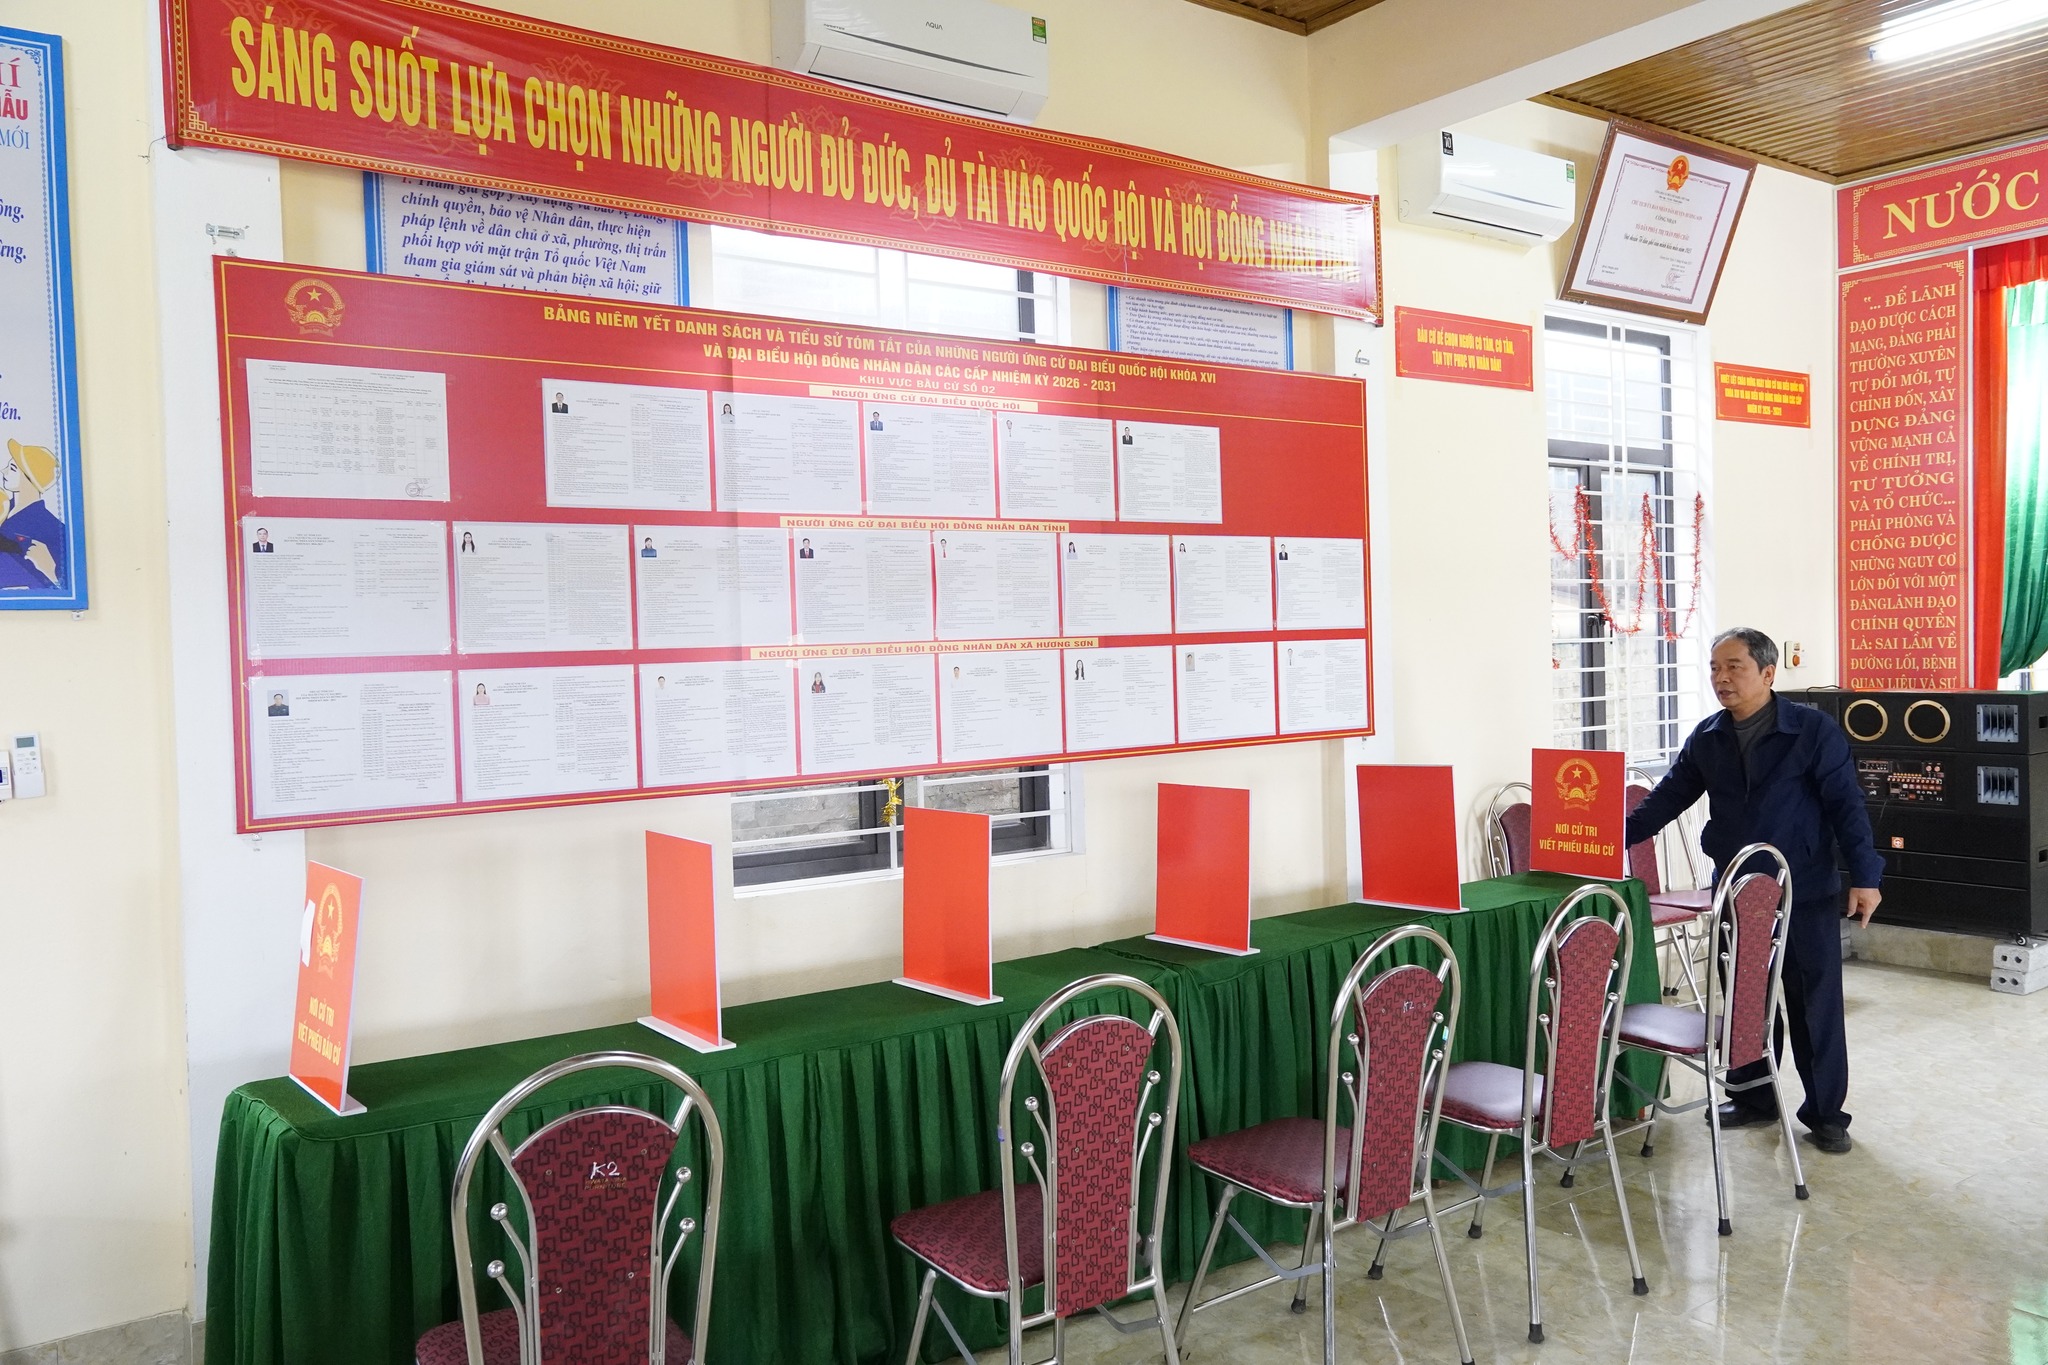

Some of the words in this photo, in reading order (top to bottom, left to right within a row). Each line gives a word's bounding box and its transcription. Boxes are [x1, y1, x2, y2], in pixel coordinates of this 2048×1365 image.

[925, 21, 944, 30] AQUA
[0, 88, 29, 121] ẪU
[230, 6, 338, 112] SÁNG
[350, 26, 440, 129] SUỐT
[450, 61, 516, 155] LỰA
[524, 76, 612, 171] CHỌN
[620, 90, 723, 179] NHỮNG
[730, 112, 814, 193] NGƯỜI
[821, 116, 855, 200] ĐỦ
[862, 133, 919, 219] ĐỨC,
[924, 137, 958, 219] ĐỦ
[962, 151, 998, 225] TÀI
[1004, 159, 1045, 232] VÀO
[1052, 166, 1108, 242] QUỐC
[1113, 181, 1146, 259] HỘI
[1151, 188, 1177, 254] VÀ
[1181, 194, 1212, 269] HỘI
[1216, 194, 1266, 267] ĐỒNG
[1269, 213, 1316, 275] NHÂN
[402, 193, 438, 208] chính
[443, 198, 485, 216] quyền,
[489, 204, 511, 218] bảo
[515, 208, 528, 223] vệ
[532, 210, 565, 225] Nhân
[569, 215, 594, 231] dân,
[598, 219, 623, 236] thực
[627, 223, 650, 239] hiện
[1882, 168, 2040, 240] NƯỚC
[402, 213, 434, 231] pháp
[439, 216, 466, 233] lệnh
[471, 219, 484, 234] về
[488, 223, 510, 237] dân
[515, 227, 537, 241] chủ
[541, 230, 550, 242] ở
[552, 232, 570, 247] xã,
[574, 235, 622, 255] phường,
[626, 242, 640, 258] thị
[644, 242, 666, 258] trấn
[404, 253, 436, 268] tham
[441, 258, 460, 273] gia
[465, 260, 495, 276] giám
[500, 265, 517, 277] sát
[521, 267, 534, 279] và
[538, 269, 567, 284] phản
[572, 272, 596, 289] biện
[600, 276, 613, 288] xã
[617, 277, 639, 293] hội;
[643, 281, 662, 296] giữ
[1885, 285, 1906, 307] ĐỂ
[1911, 283, 1956, 303] LÃNH
[1850, 318, 1876, 336] ĐẠO
[1879, 312, 1915, 330] ĐƯỢC
[1919, 303, 1956, 322] CÁCH
[544, 304, 590, 324] BẢNG
[596, 310, 638, 329] NIÊM
[643, 311, 670, 332] YẾT
[675, 319, 717, 336] DANH
[722, 321, 761, 340] SÁCH
[766, 325, 784, 343] VÀ
[788, 325, 819, 346] TIỂU
[823, 330, 842, 348] SỬ
[845, 333, 874, 351] TÓM
[878, 333, 902, 354] TẮT
[905, 338, 931, 356] CỦA
[935, 342, 978, 361] NHỮNG
[982, 346, 1018, 364] NGƯỜI
[1022, 348, 1046, 367] ỨNG
[1050, 352, 1066, 369] CỬ
[1068, 356, 1087, 374] ĐẠI
[1090, 353, 1115, 374] BIỂU
[1118, 356, 1146, 376] QUỐC
[1150, 361, 1167, 382] HỘI
[1170, 363, 1197, 381] KHÓA
[1200, 368, 1216, 383] XVI
[1850, 338, 1886, 356] MẠNG,
[1889, 329, 1922, 348] ĐẢNG
[1926, 323, 1956, 343] PHẢI
[703, 342, 722, 358] VÀ
[727, 347, 752, 364] ĐẠI
[756, 345, 789, 364] BIỂU
[794, 350, 817, 369] HỘI
[821, 350, 859, 370] ĐỒNG
[863, 357, 900, 374] NHÂN
[904, 360, 931, 376] DÂN
[935, 363, 960, 378] CÁC
[964, 363, 988, 381] CẤP
[992, 369, 1031, 387] NHIỆM
[1034, 371, 1048, 386] KỲ
[1052, 376, 1080, 389] 2026
[1090, 379, 1115, 392] 2031
[1849, 352, 1906, 373] THƯỜNG
[1909, 344, 1955, 365] XUYÊN
[859, 376, 884, 385] KHU
[888, 378, 912, 388] VỰC
[916, 378, 939, 389] BẦU
[943, 381, 958, 390] CỬ
[963, 381, 977, 392] SỐ
[1849, 380, 1867, 396] TỰ
[1871, 370, 1896, 390] ĐỔI
[1900, 369, 1932, 386] MỚI,
[1935, 368, 1954, 384] TỰ
[1850, 394, 1890, 413] CHỈNH
[1894, 388, 1926, 407] ĐỐN,
[1929, 386, 1954, 403] XÂY
[1850, 416, 1899, 435] DỰNG
[1904, 408, 1955, 427] ĐẢNG
[1850, 435, 1887, 452] VỮNG
[1891, 434, 1932, 451] MẠNH
[1936, 427, 1956, 444] CẢ
[1849, 453, 1868, 472] VỀ
[1872, 452, 1920, 470] CHÍNH
[1925, 452, 1956, 467] TRỊ,
[1849, 479, 1875, 492] TƯ
[1881, 470, 1954, 489] TƯỞNG
[1850, 495, 1869, 512] VÀ
[1873, 491, 1894, 510] TỔ
[1898, 490, 1955, 508] CHỨC...
[1555, 824, 1569, 834] NƠI
[1571, 823, 1582, 835] CỬ
[1585, 826, 1597, 836] TRI
[1539, 836, 1555, 850] VIẾT
[1557, 838, 1581, 853] PHIẾU
[1602, 844, 1614, 856] CỬ
[590, 1162, 621, 1179] K2
